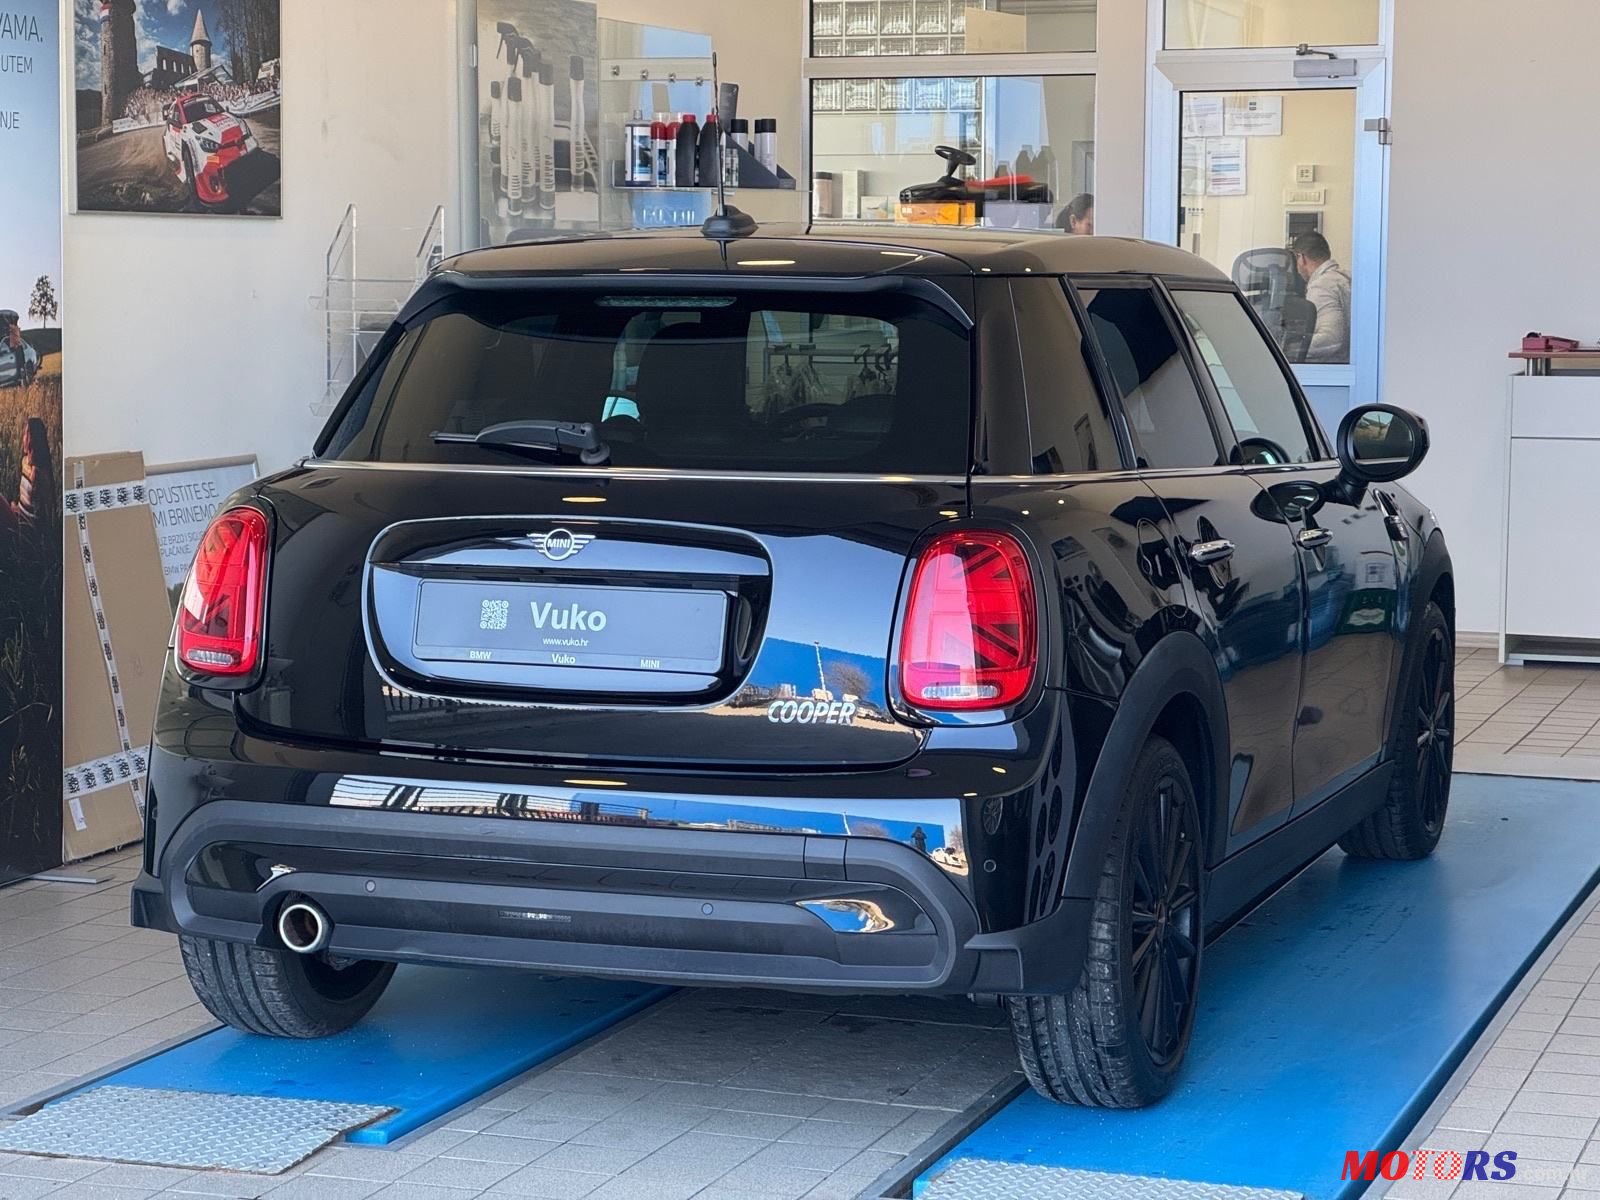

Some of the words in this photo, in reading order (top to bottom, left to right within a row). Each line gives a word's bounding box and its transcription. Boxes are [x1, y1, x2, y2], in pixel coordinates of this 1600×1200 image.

[547, 538, 571, 549] MINI
[530, 601, 607, 632] Vuko
[542, 636, 590, 647] www.vuko.hr
[469, 650, 492, 660] BMW
[551, 653, 576, 665] Vuko
[640, 658, 660, 669] MINI
[767, 700, 857, 725] COOPER
